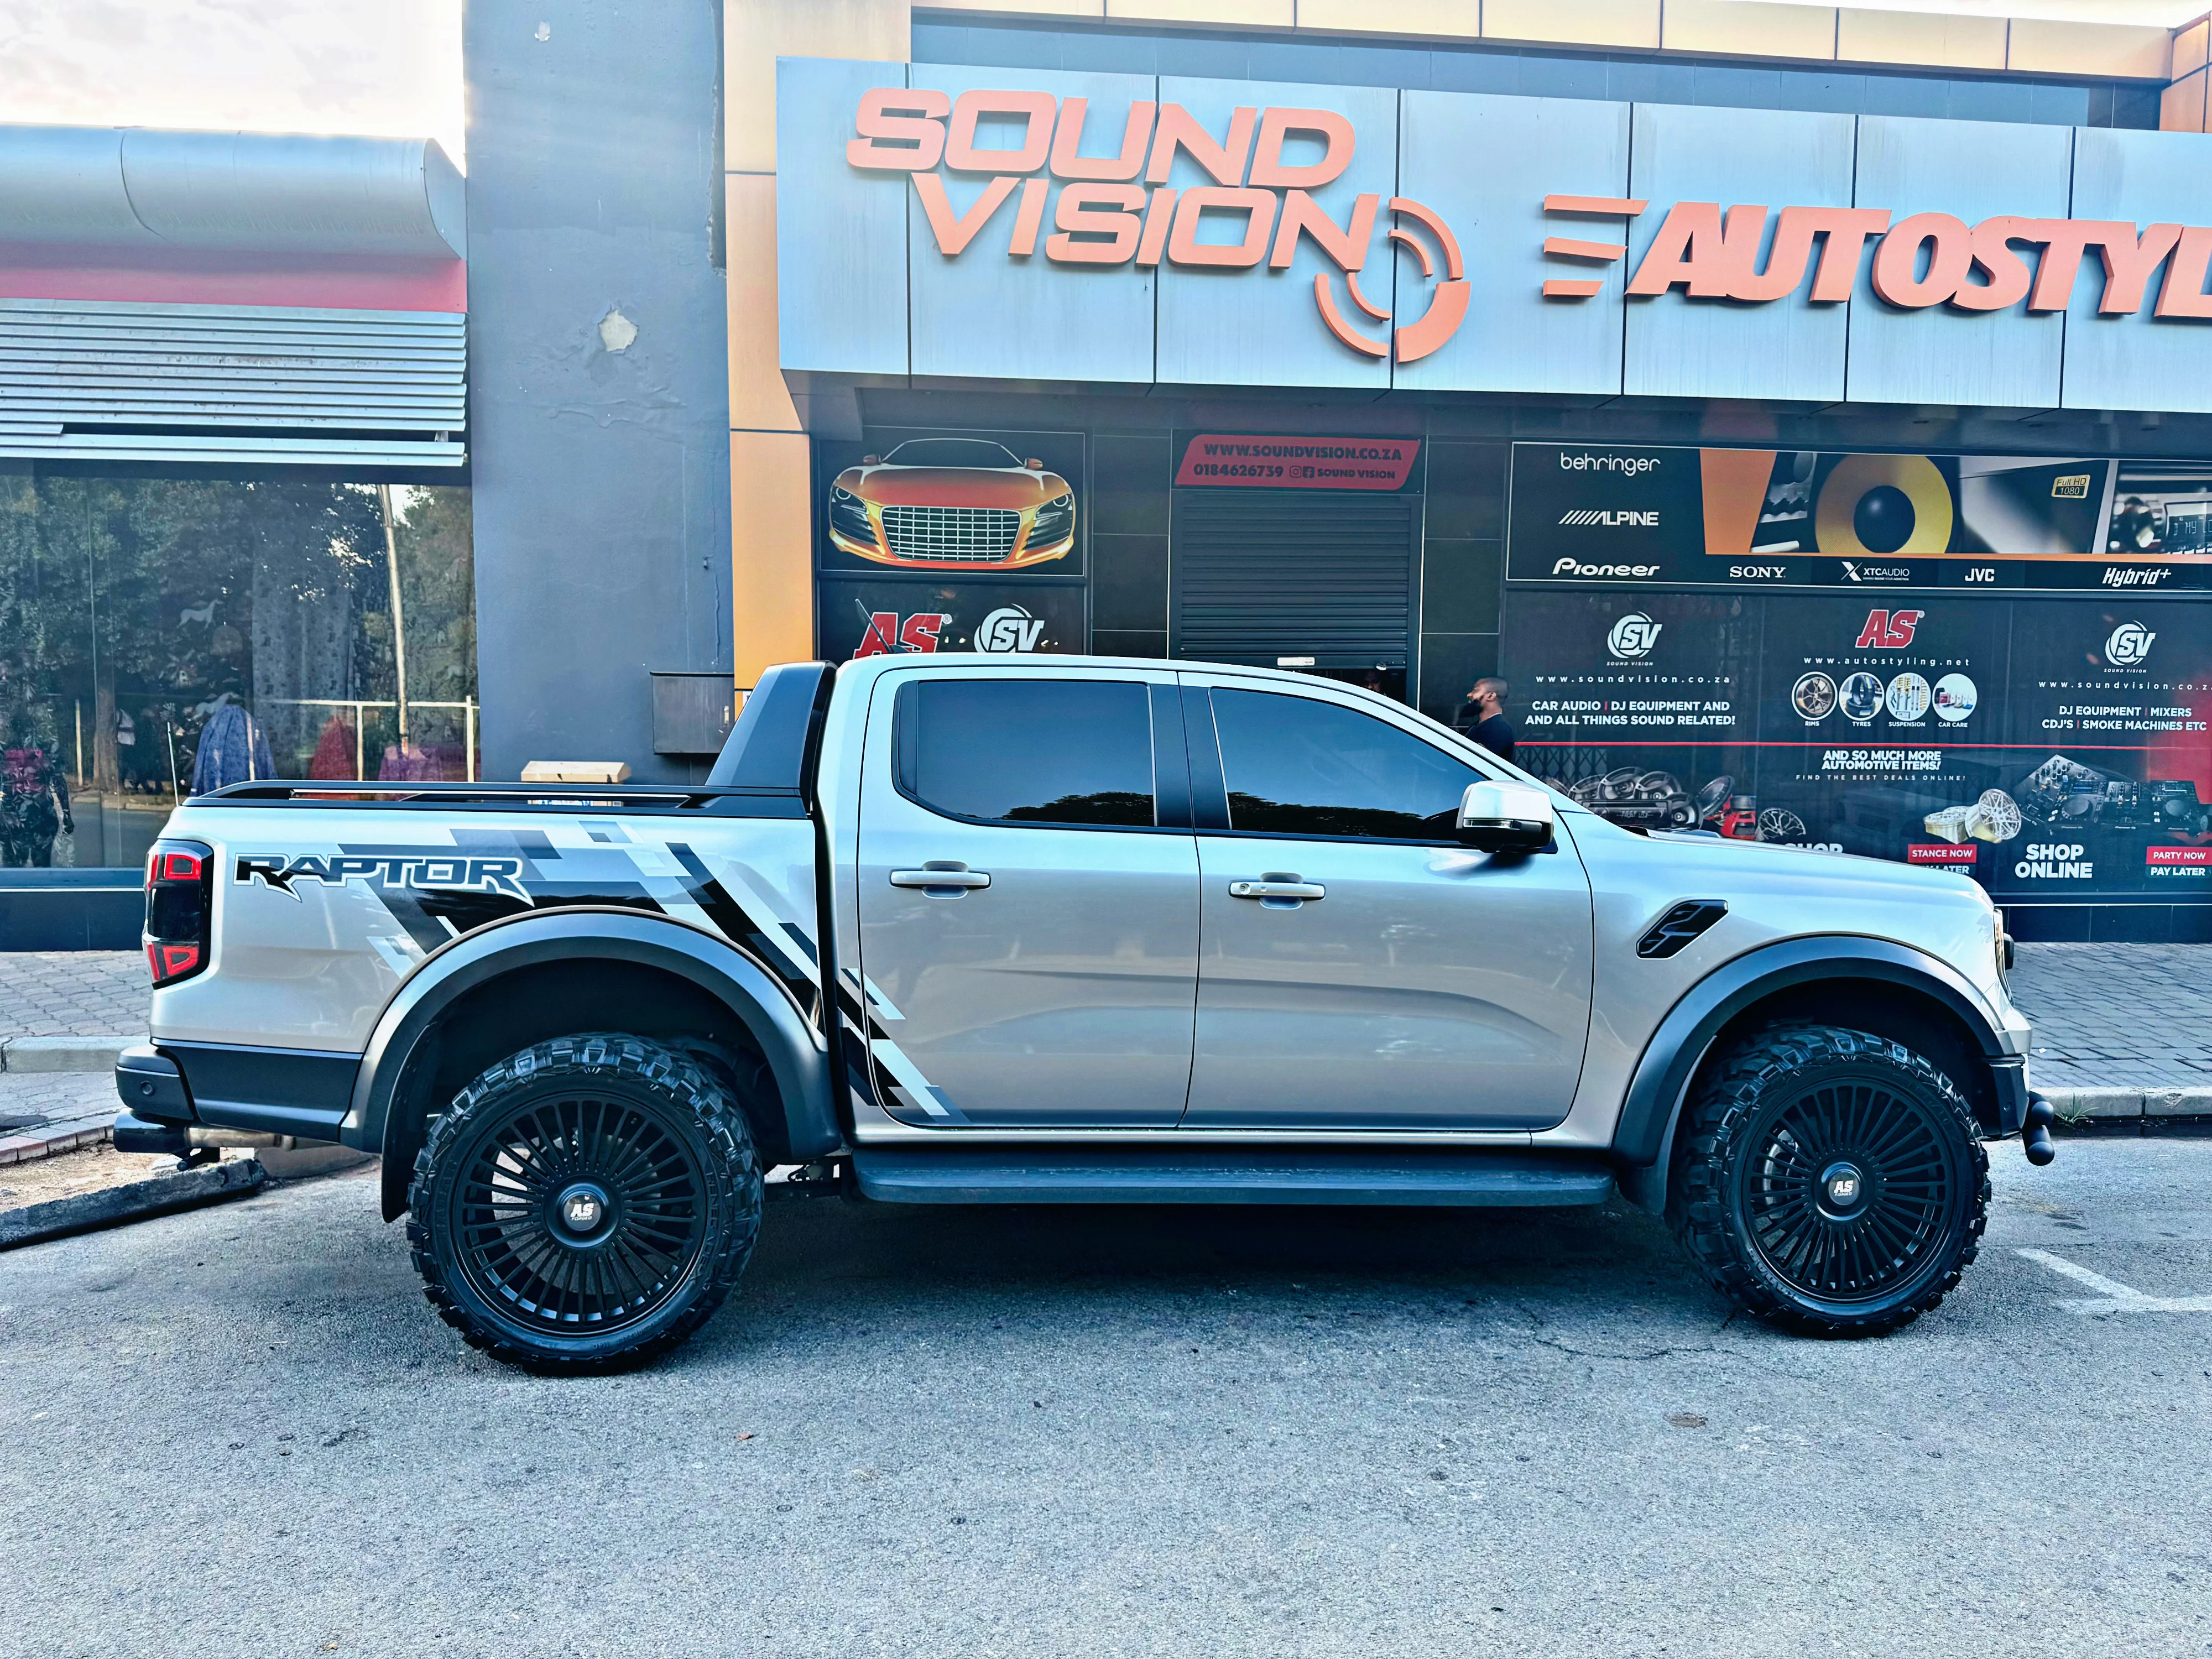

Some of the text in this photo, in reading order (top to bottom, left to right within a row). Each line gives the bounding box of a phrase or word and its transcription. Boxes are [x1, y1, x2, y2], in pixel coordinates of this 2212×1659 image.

[847, 87, 1356, 189] SOUND
[911, 172, 1380, 273] VISION
[1624, 201, 2212, 318] AUTOSTYL
[1203, 444, 1402, 461] WWW.SOUNDVISION.CO.ZA
[1193, 463, 1284, 478] 0184626739
[1560, 452, 1661, 477] behringer
[1317, 468, 1395, 479] SOUND VISION
[2060, 487, 2080, 495] 1080
[1592, 510, 1659, 526] ALPINE
[1552, 557, 1660, 577] Pioneer
[1730, 566, 1785, 578] SONY
[1863, 568, 1910, 576] XTCAUDIO
[1965, 568, 1995, 582] JVC
[2102, 567, 2172, 587] Hybrid+
[1804, 657, 1970, 666] www.autostyling.net
[1536, 675, 1730, 684] www.soundvision.co.za
[2039, 681, 2212, 690] www.soundvision.co.z
[1532, 701, 1730, 711] CAR AUDIO DJ EQUIPMENT AND
[2059, 706, 2192, 717] DJ EQUIPMENT MIXERS
[1525, 715, 1735, 725] AND ALL THINGS SOUND RELATED!
[2082, 720, 2122, 729] SMOKE
[2125, 721, 2183, 731] MACHINES
[2185, 721, 2207, 731] ETC
[1823, 750, 1942, 761] AND SO MUCH MORE
[1822, 760, 1941, 770] AUTOMOTIVE ITEMS!
[1912, 849, 1947, 858] STANCE
[2025, 844, 2084, 860] SHOP
[2015, 862, 2093, 879] ONLINE
[2151, 867, 2206, 877] PAY LATER
[233, 853, 535, 907] RAPTOR
[1834, 1180, 1854, 1193] AS
[570, 1203, 594, 1217] AS
